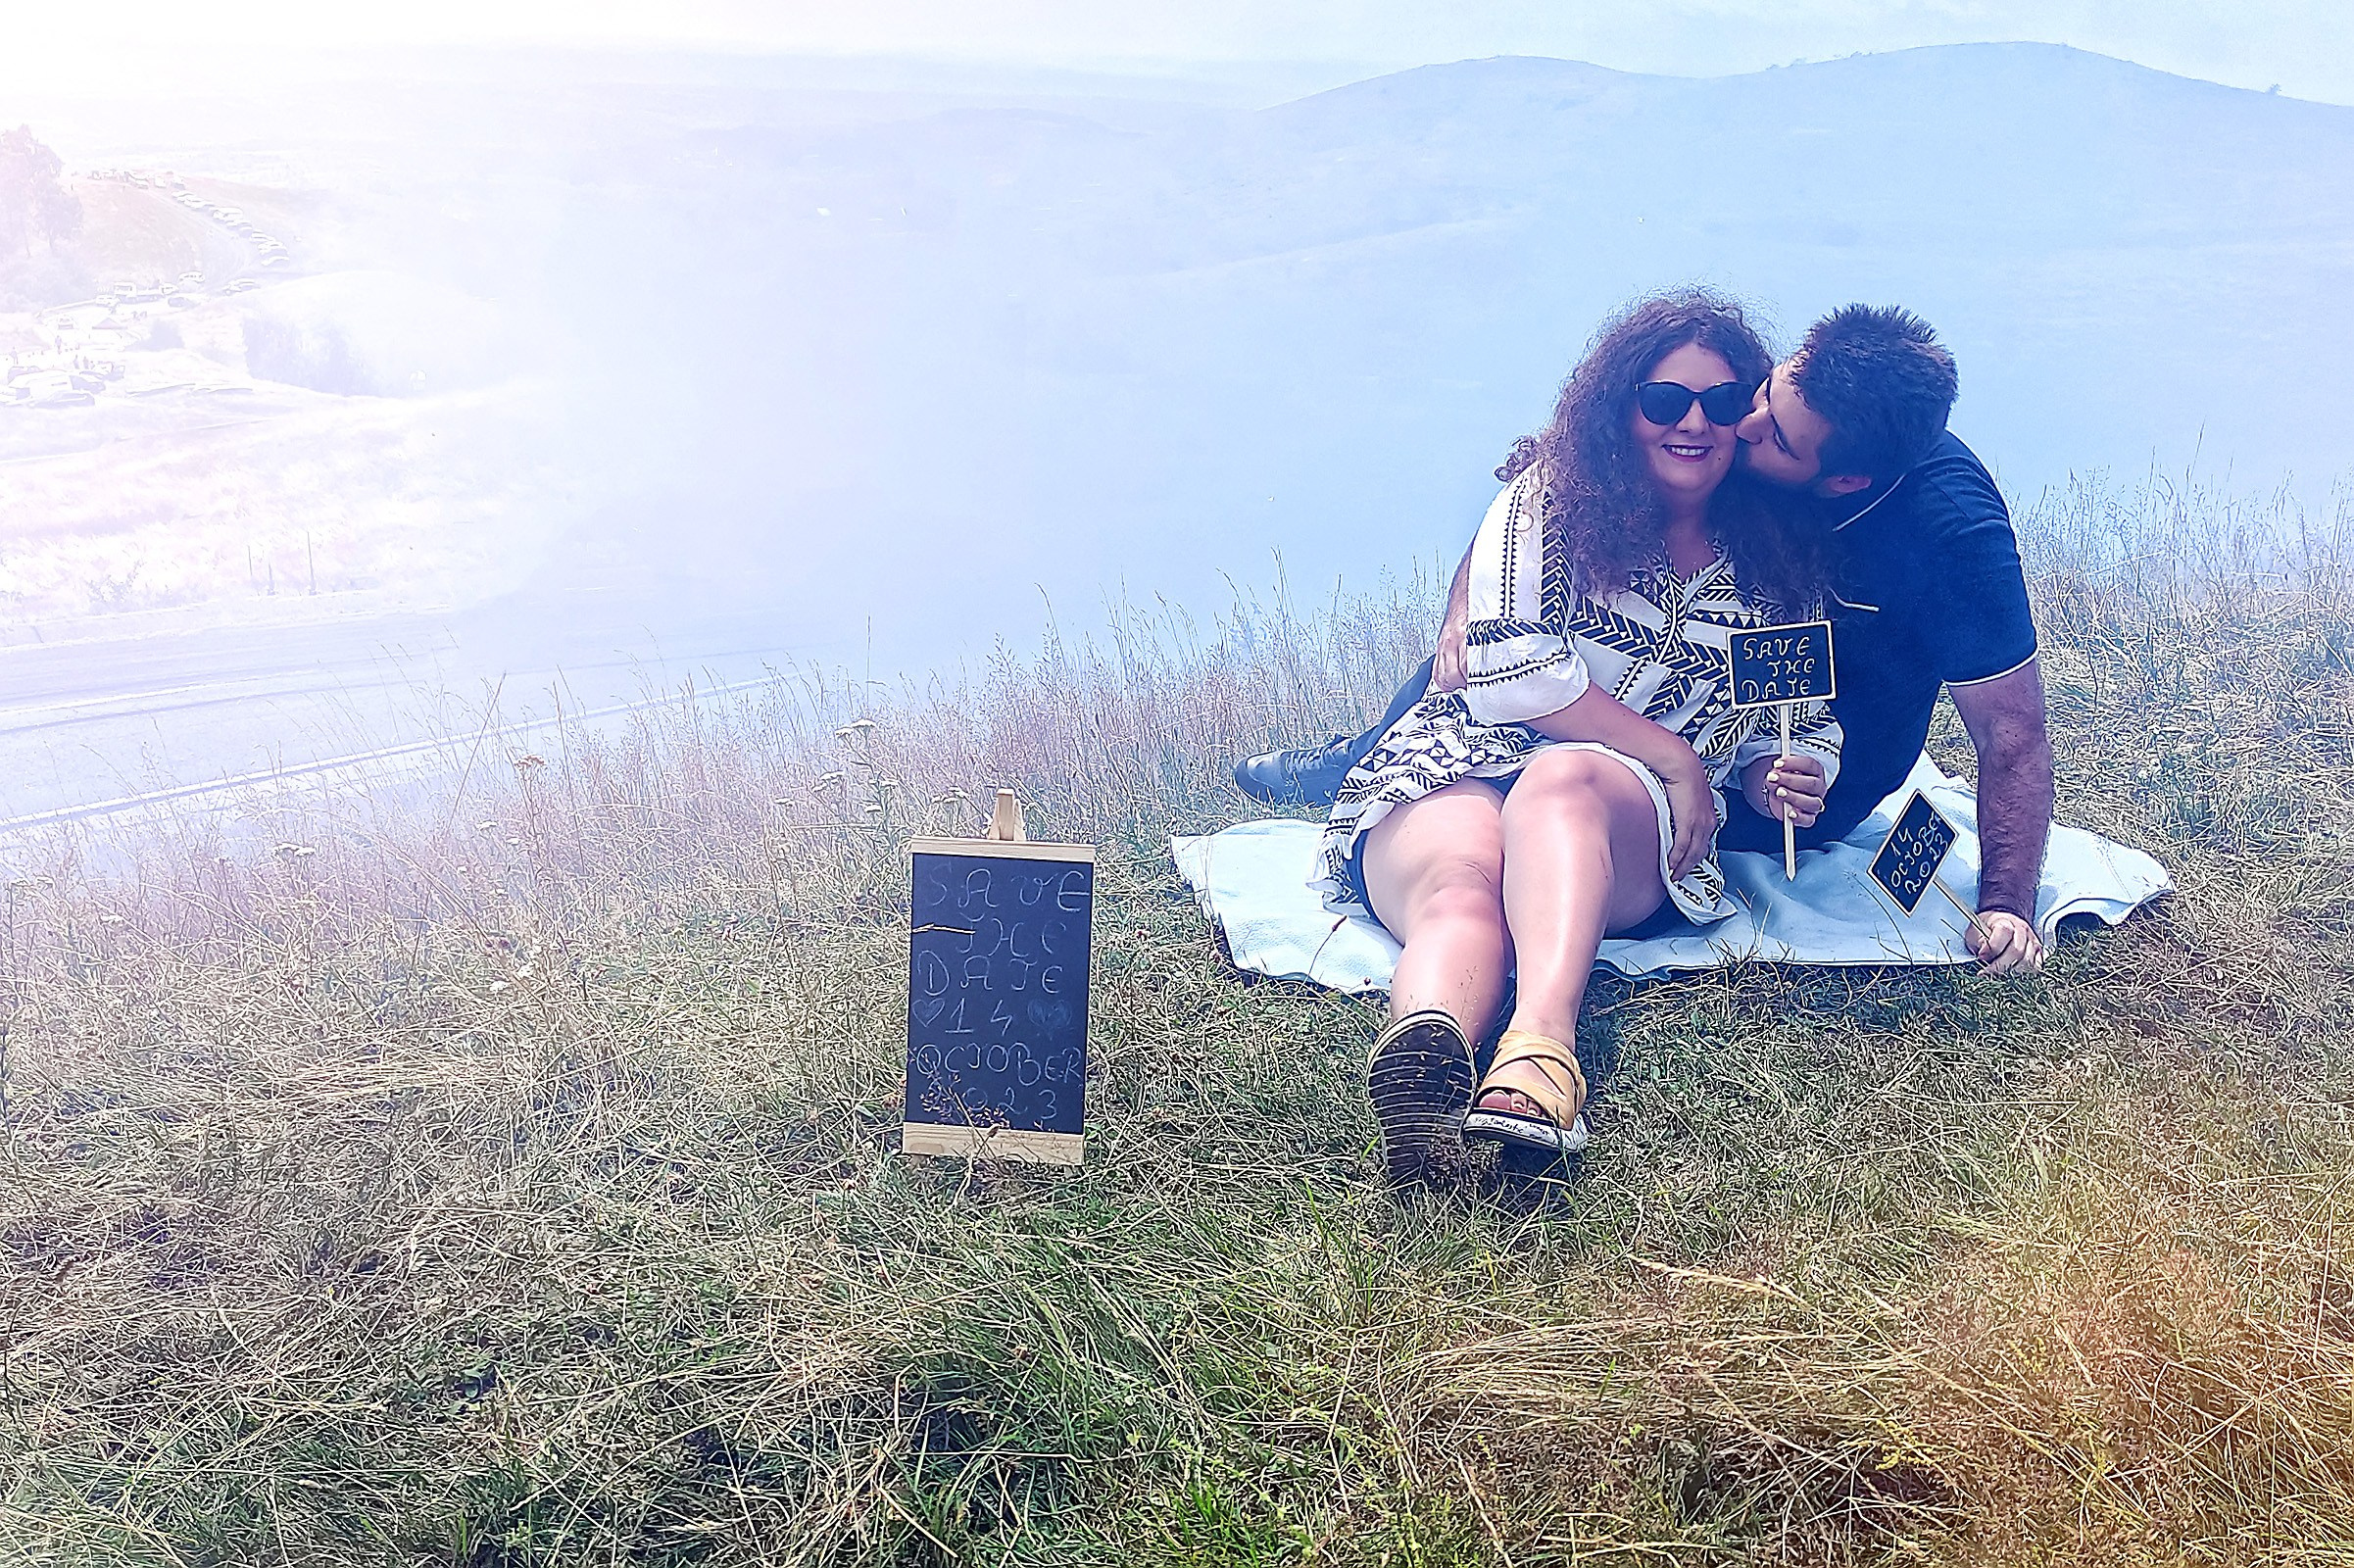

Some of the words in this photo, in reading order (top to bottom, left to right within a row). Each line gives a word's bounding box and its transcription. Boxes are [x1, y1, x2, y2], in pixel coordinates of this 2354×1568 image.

[1743, 636, 1810, 661] SAVE
[1767, 658, 1815, 677] THE
[1741, 677, 1811, 703] DATE
[1890, 827, 1914, 858] 14
[1904, 832, 1948, 895] 2023
[929, 864, 1090, 912] SAVE
[956, 912, 1067, 958] THE
[916, 950, 1064, 997] DATE
[945, 998, 1013, 1036] 14
[916, 1042, 1084, 1087] OCTOBER
